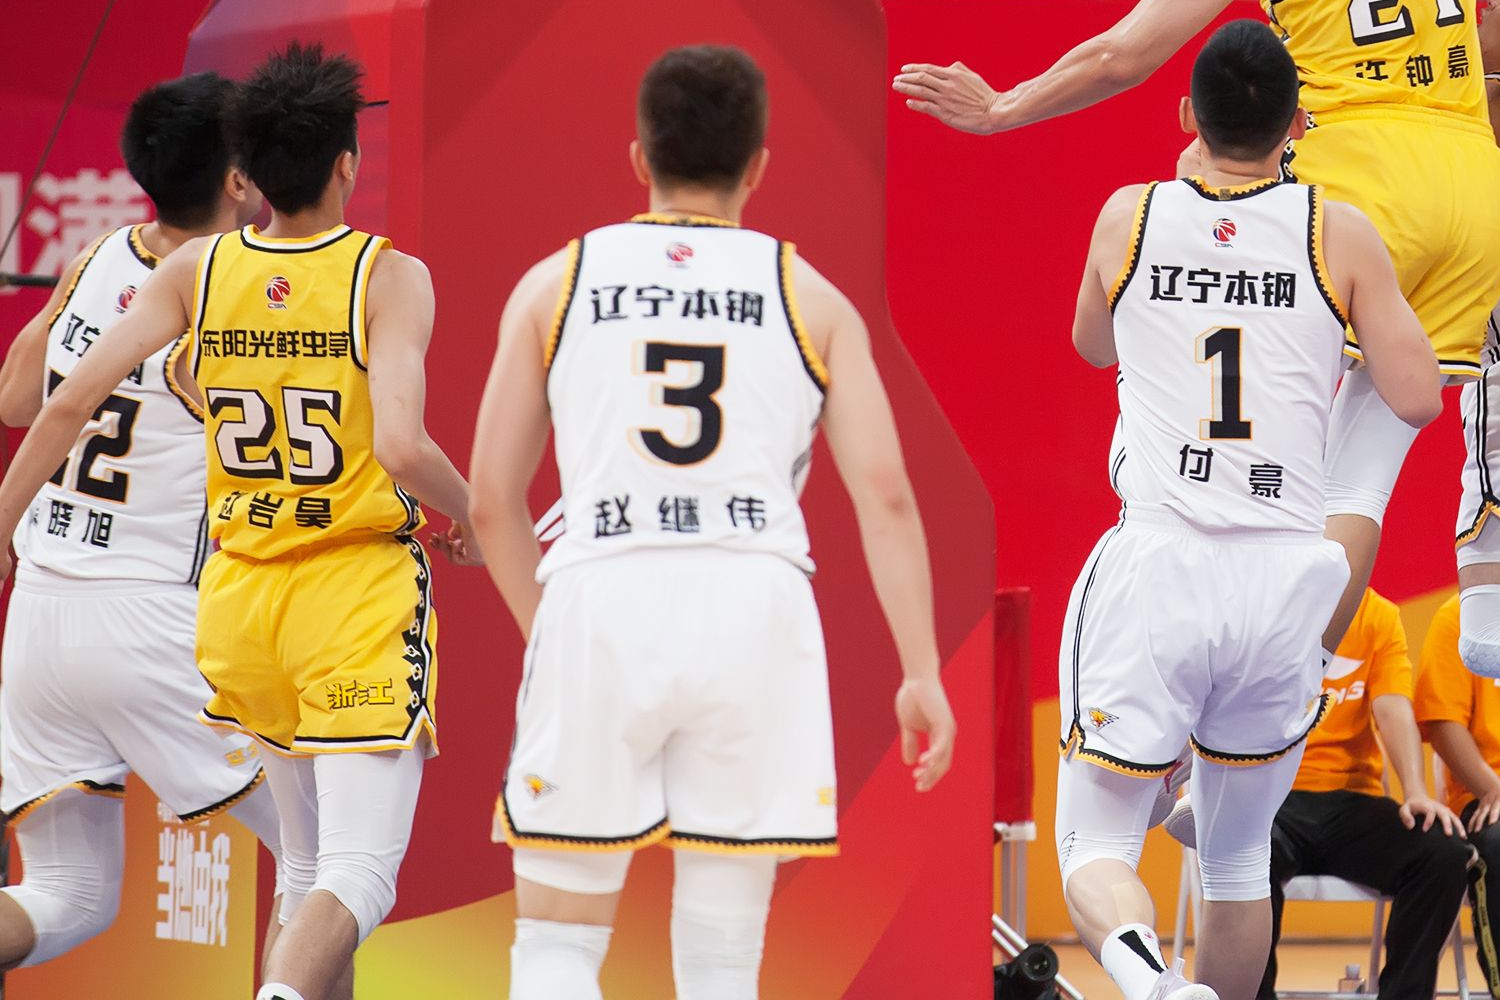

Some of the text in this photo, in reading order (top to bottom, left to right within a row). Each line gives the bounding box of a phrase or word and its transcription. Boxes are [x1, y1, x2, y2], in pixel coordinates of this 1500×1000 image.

[591, 285, 764, 327] 辽宁本钢
[1150, 265, 1296, 308] 辽宁本钢
[202, 329, 350, 358] 东阳光鲜虫草
[1195, 326, 1253, 440] 1
[627, 341, 727, 470] 3
[205, 386, 344, 486] 25
[1179, 444, 1284, 499] 付豪
[594, 494, 767, 538] 赵继伟
[326, 677, 395, 710] 浙江
